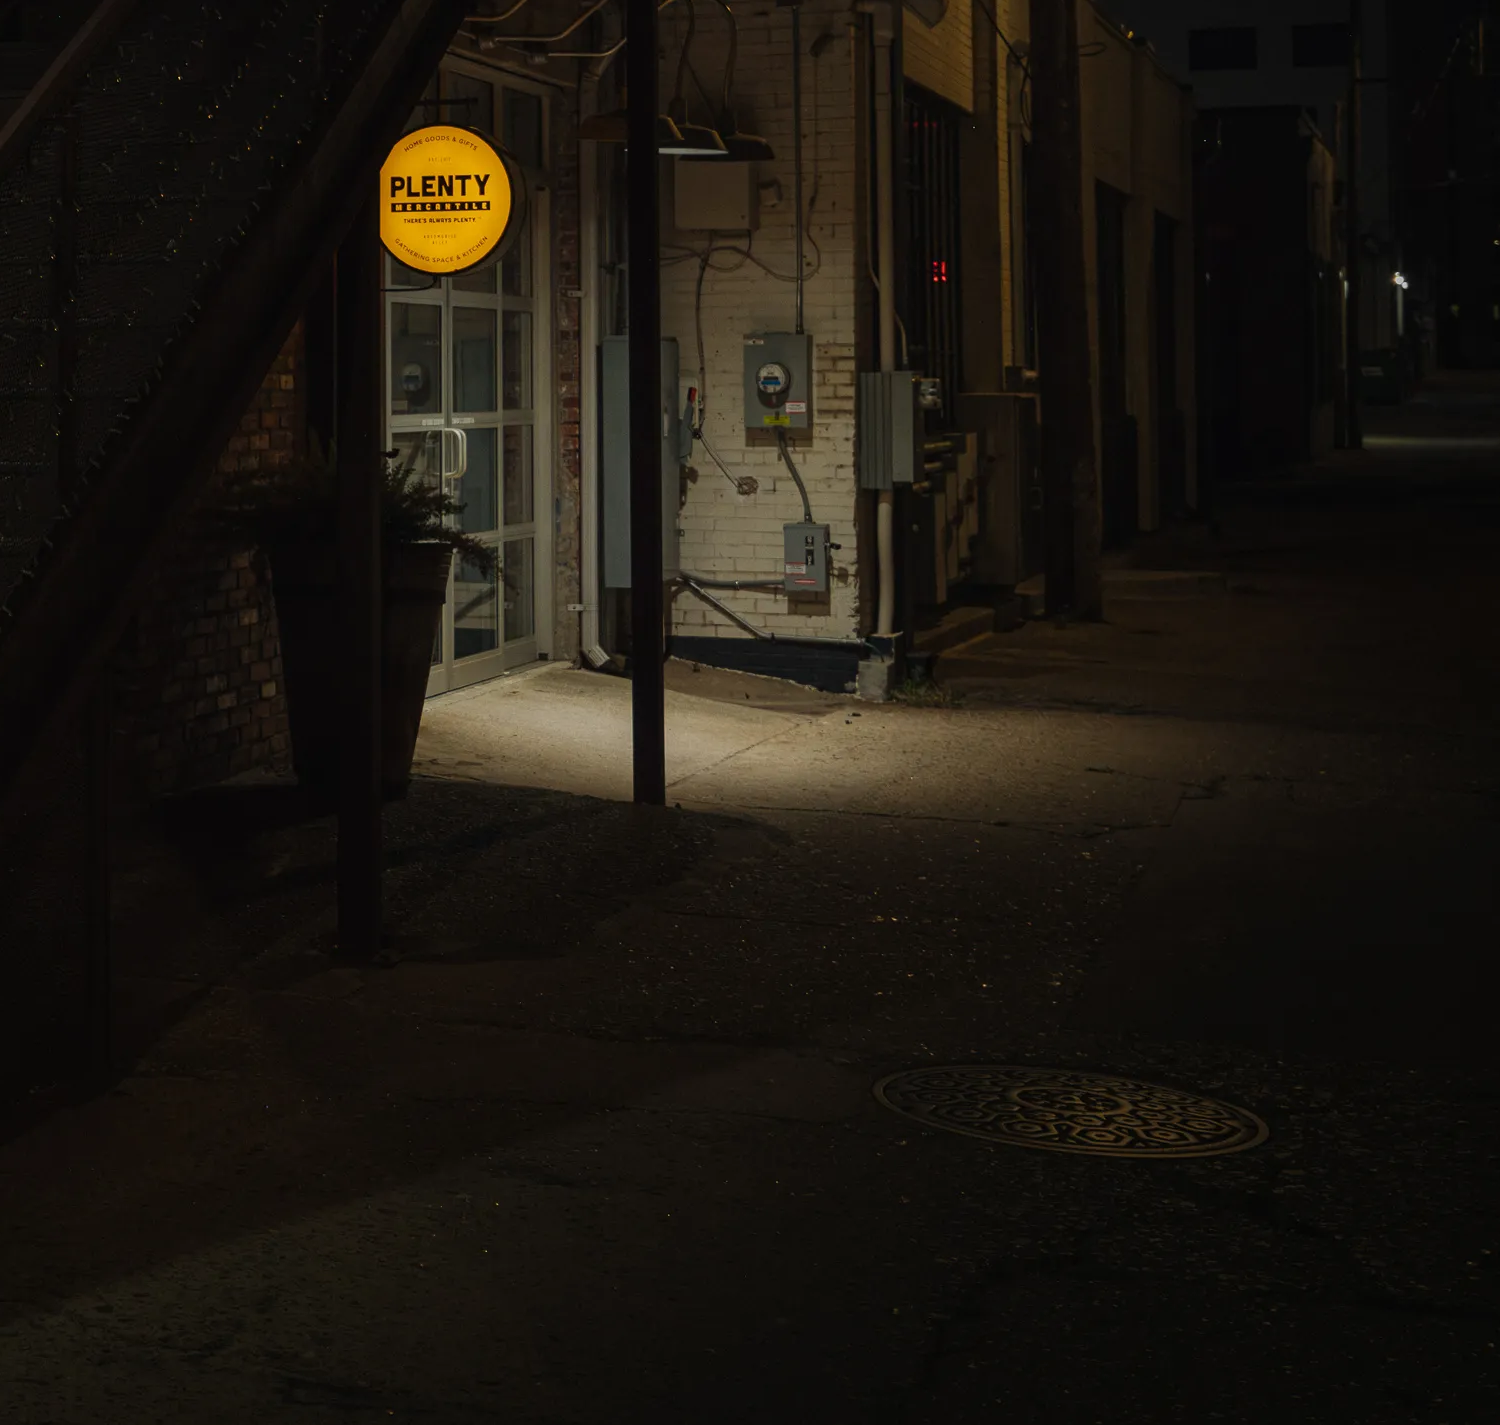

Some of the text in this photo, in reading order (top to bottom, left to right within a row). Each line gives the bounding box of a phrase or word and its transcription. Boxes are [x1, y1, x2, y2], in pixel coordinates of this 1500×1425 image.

[403, 138, 423, 153] HOME
[424, 135, 450, 143] GOODS
[458, 138, 478, 151] GIFTS
[390, 173, 491, 198] PLENTY
[395, 202, 487, 211] MERCANTILE
[394, 238, 430, 262] GATHERING
[462, 235, 488, 257] KITCHEN
